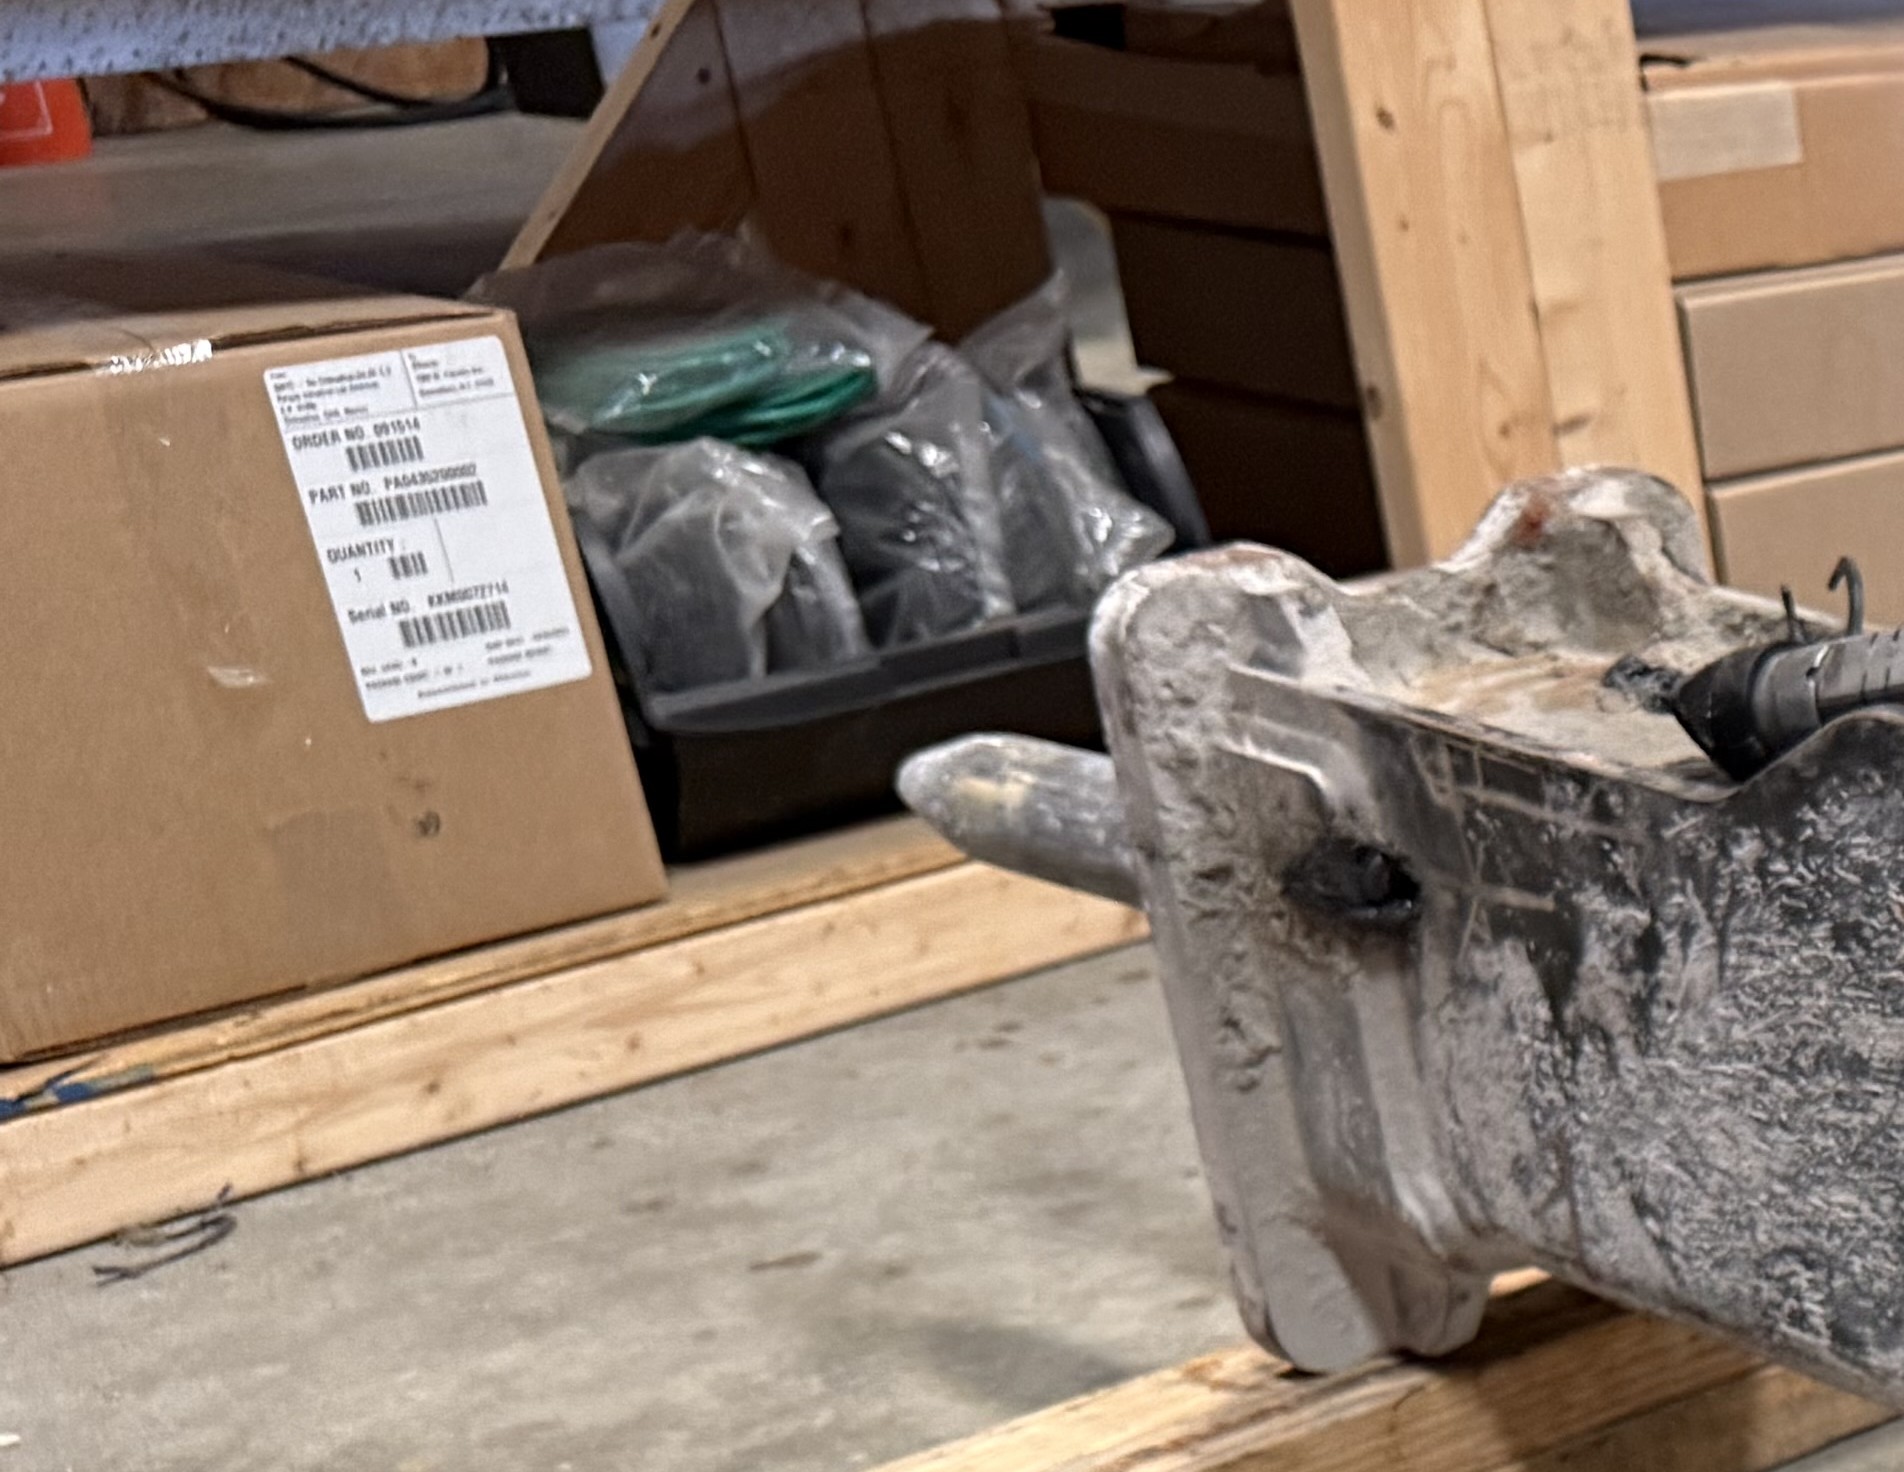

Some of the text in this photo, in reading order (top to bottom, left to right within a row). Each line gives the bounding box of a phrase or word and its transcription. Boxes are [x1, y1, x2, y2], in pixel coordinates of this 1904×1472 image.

[290, 429, 342, 450] ORDER
[307, 484, 346, 504] PART
[326, 539, 395, 563] QUANTITY
